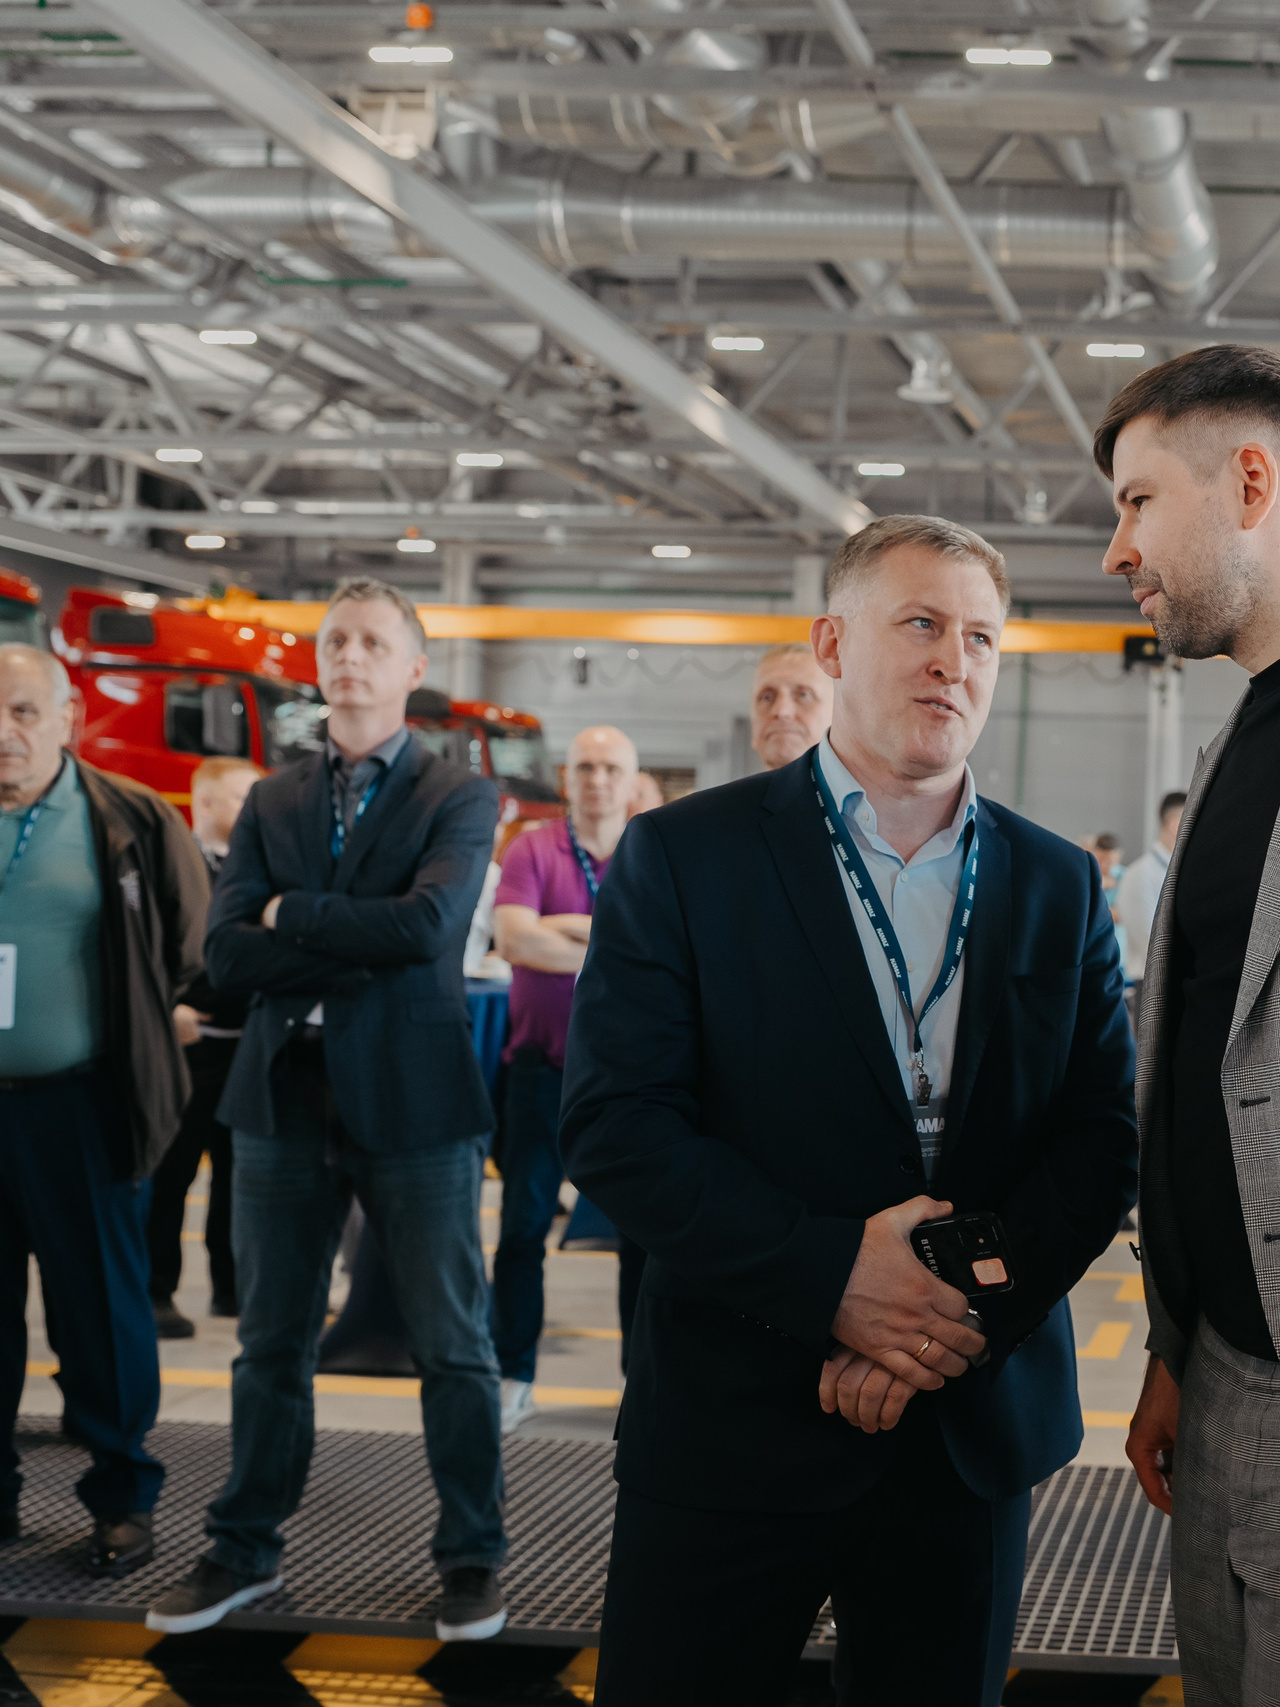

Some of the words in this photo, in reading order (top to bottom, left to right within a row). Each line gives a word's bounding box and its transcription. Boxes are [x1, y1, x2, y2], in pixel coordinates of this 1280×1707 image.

[836, 843, 849, 862] KAMAZ
[849, 870, 863, 890] KAMAZ
[862, 898, 876, 918] KAMAZ
[876, 927, 890, 948] KAMAZ
[955, 936, 965, 957] KAMAZ
[889, 957, 902, 978] KAMAZ
[914, 1117, 946, 1134] AMA
